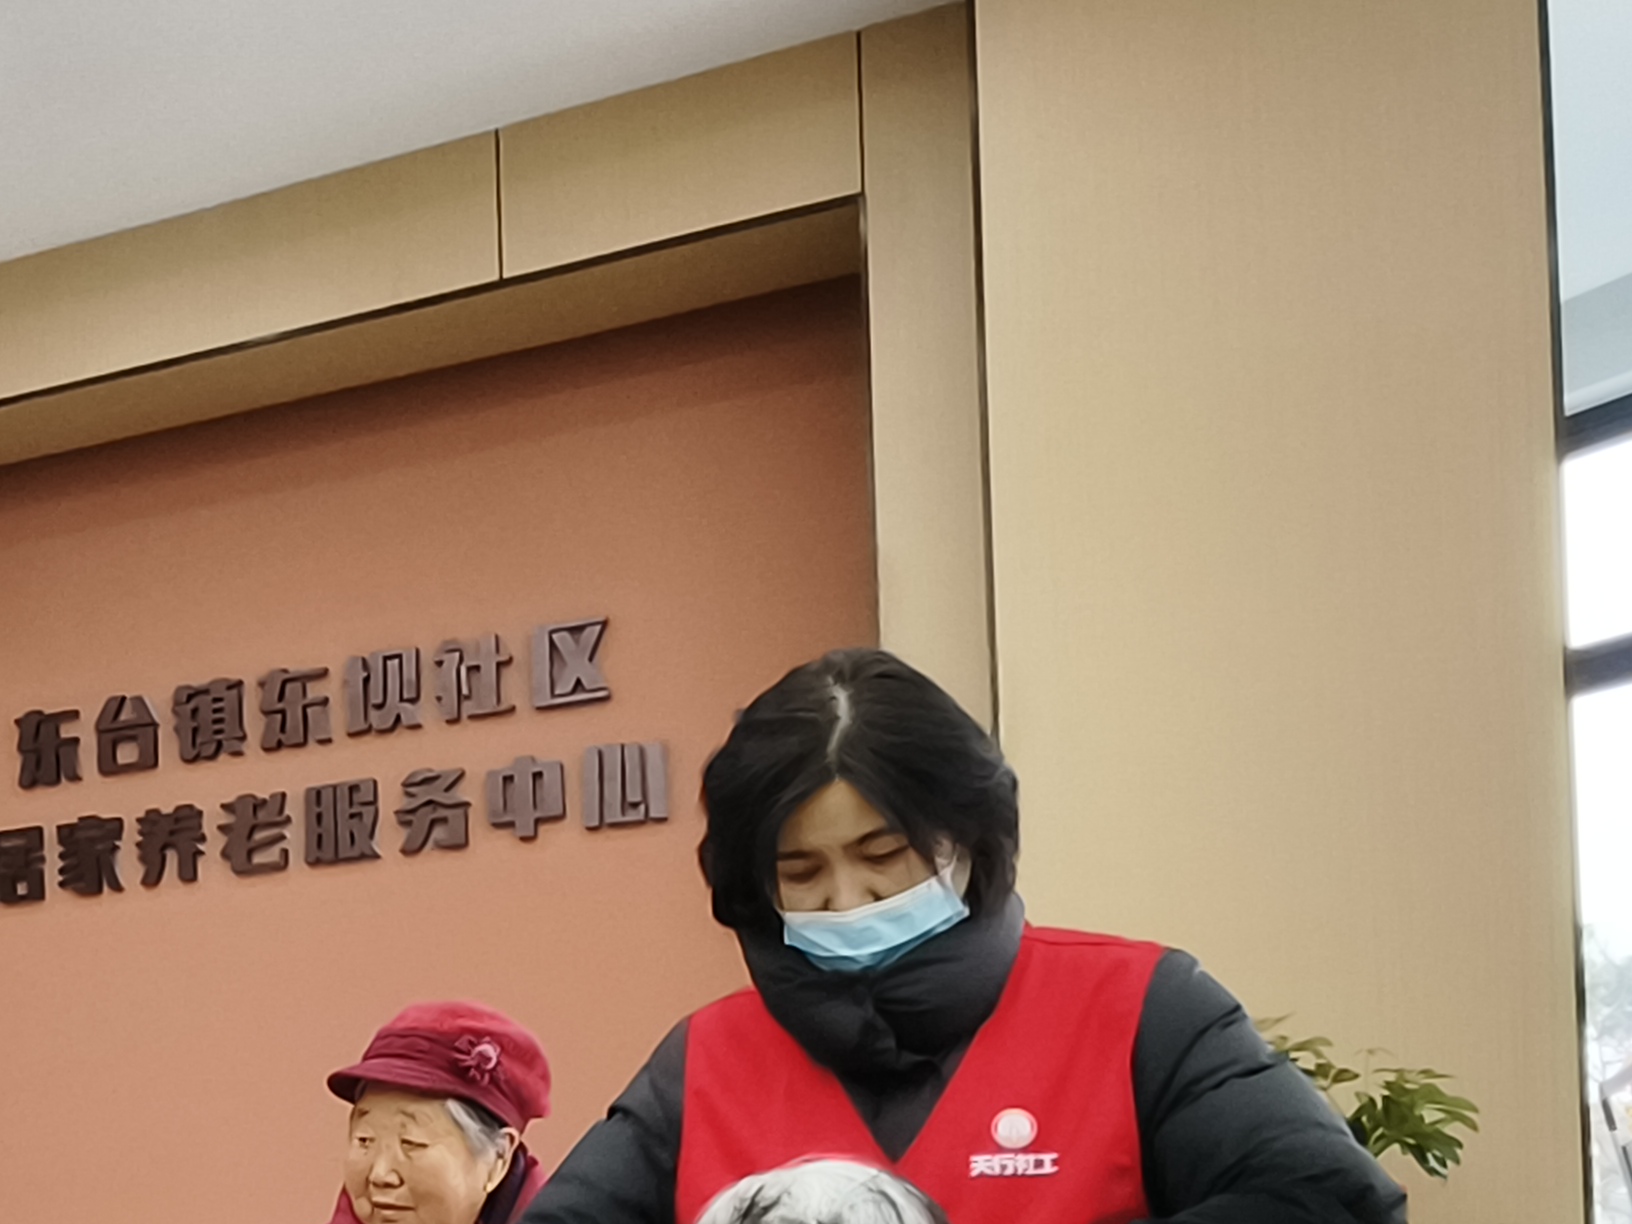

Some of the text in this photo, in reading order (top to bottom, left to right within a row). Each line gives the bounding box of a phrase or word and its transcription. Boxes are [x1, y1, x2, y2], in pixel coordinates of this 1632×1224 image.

[14, 616, 612, 789] 东台镇东坝社区
